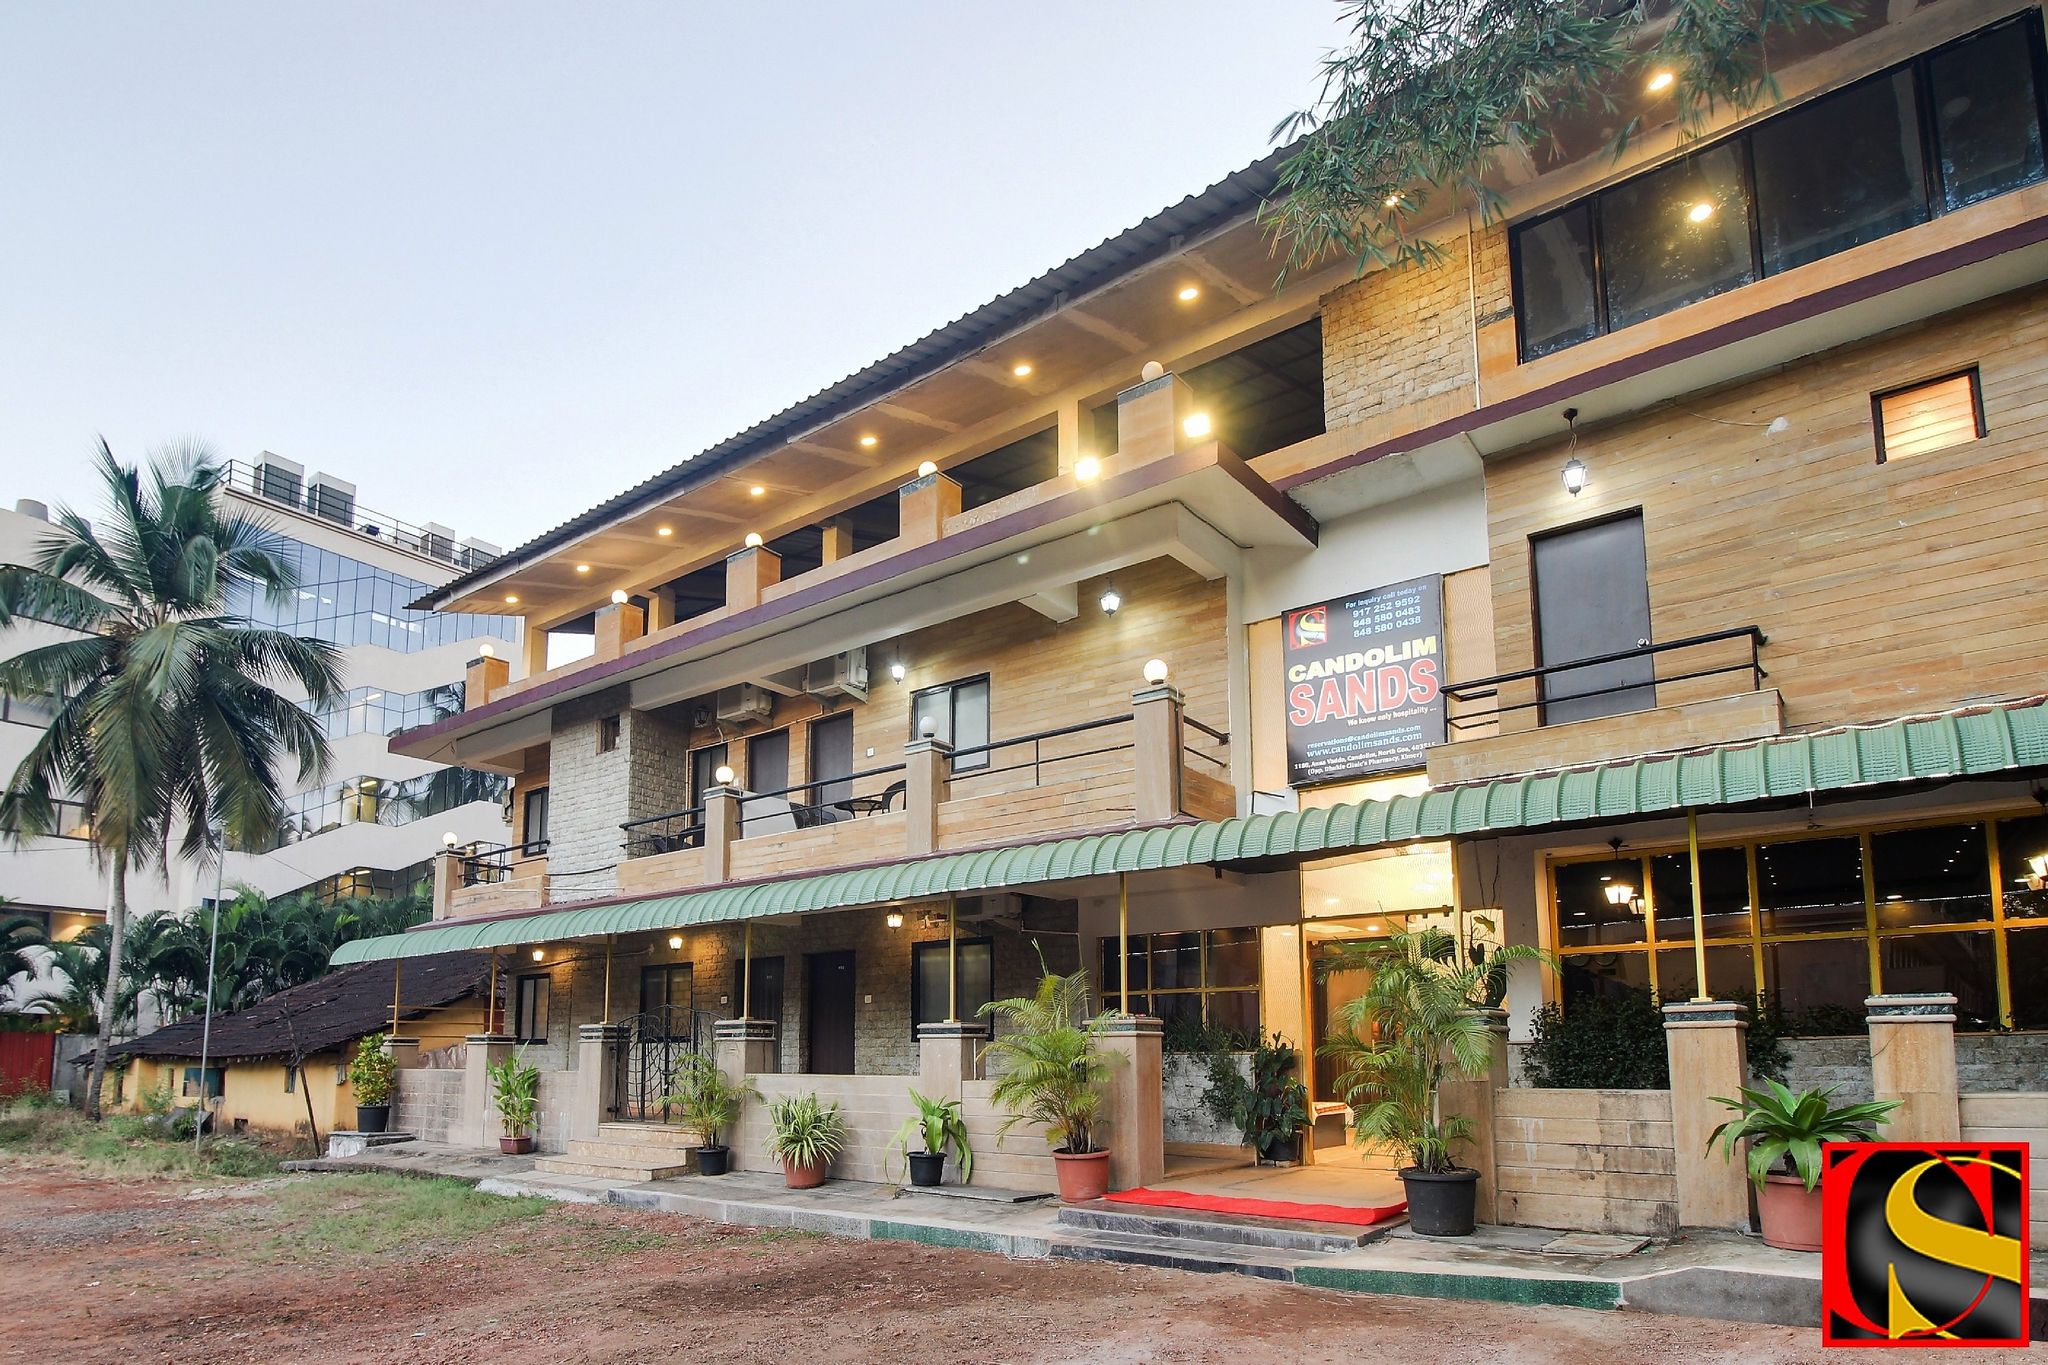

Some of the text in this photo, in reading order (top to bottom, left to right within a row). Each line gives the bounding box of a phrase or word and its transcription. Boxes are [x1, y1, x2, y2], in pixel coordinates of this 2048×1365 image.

[1382, 592, 1395, 601] call
[1397, 587, 1416, 597] today
[1352, 595, 1421, 618] 917 252 9592
[1353, 606, 1421, 628] 848 580 0483
[1353, 616, 1421, 638] 848 580 0438
[1288, 635, 1437, 683] CANDOLIM
[1289, 658, 1438, 727] SANDS
[1347, 719, 1358, 727] We
[1358, 716, 1376, 724] know
[1377, 712, 1392, 723] only
[1393, 706, 1428, 720] hospitality
[1306, 732, 1422, 758] www.candolimsands.com
[1307, 724, 1421, 749] reservations@candolimsands.com
[1377, 748, 1396, 757] North
